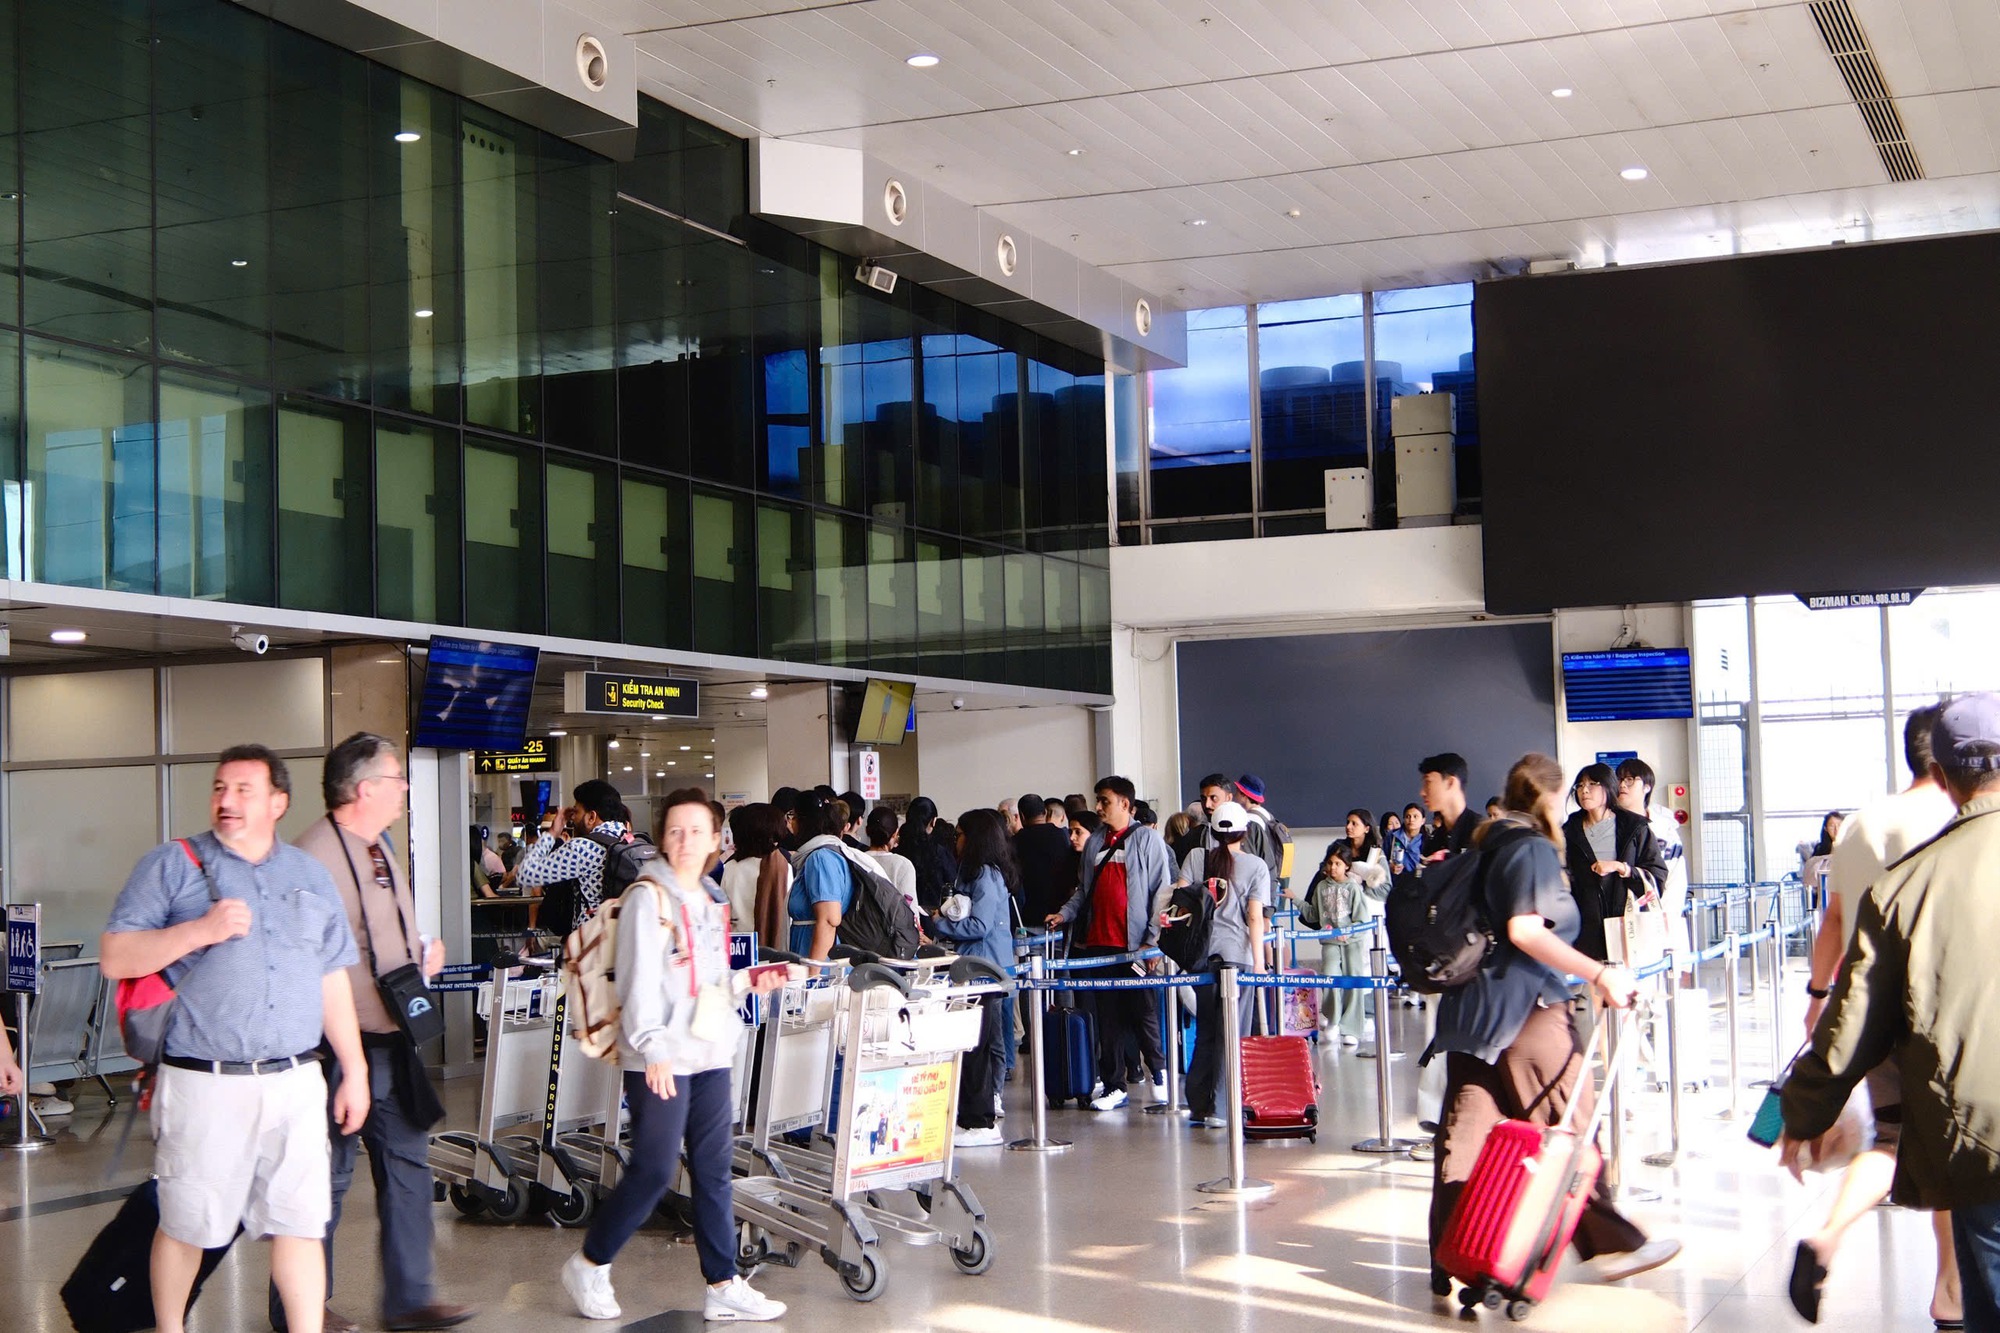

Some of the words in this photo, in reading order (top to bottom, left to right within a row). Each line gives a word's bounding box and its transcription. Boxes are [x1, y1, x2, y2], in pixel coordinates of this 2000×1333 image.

[1810, 596, 1848, 608] BIZMAN
[622, 679, 639, 695] KIỂM
[640, 685, 653, 696] TRA
[654, 686, 663, 696] AN
[665, 687, 680, 697] NINH
[622, 698, 646, 710] Security
[646, 699, 664, 709] Check
[15, 907, 23, 915] TIA
[1125, 953, 1134, 961] TIA
[1015, 965, 1024, 973] TIA
[10, 978, 25, 986] PRIORITY
[1114, 978, 1168, 986] INTERNATIONAL
[1169, 976, 1200, 984] AIRPORT
[1256, 975, 1275, 983] QUỐC
[1301, 976, 1315, 984] SƠN
[1316, 976, 1334, 984] NHẤT
[1371, 978, 1397, 987] TIA
[552, 1005, 564, 1070] GOLDSUN
[546, 1084, 556, 1129] GROUP
